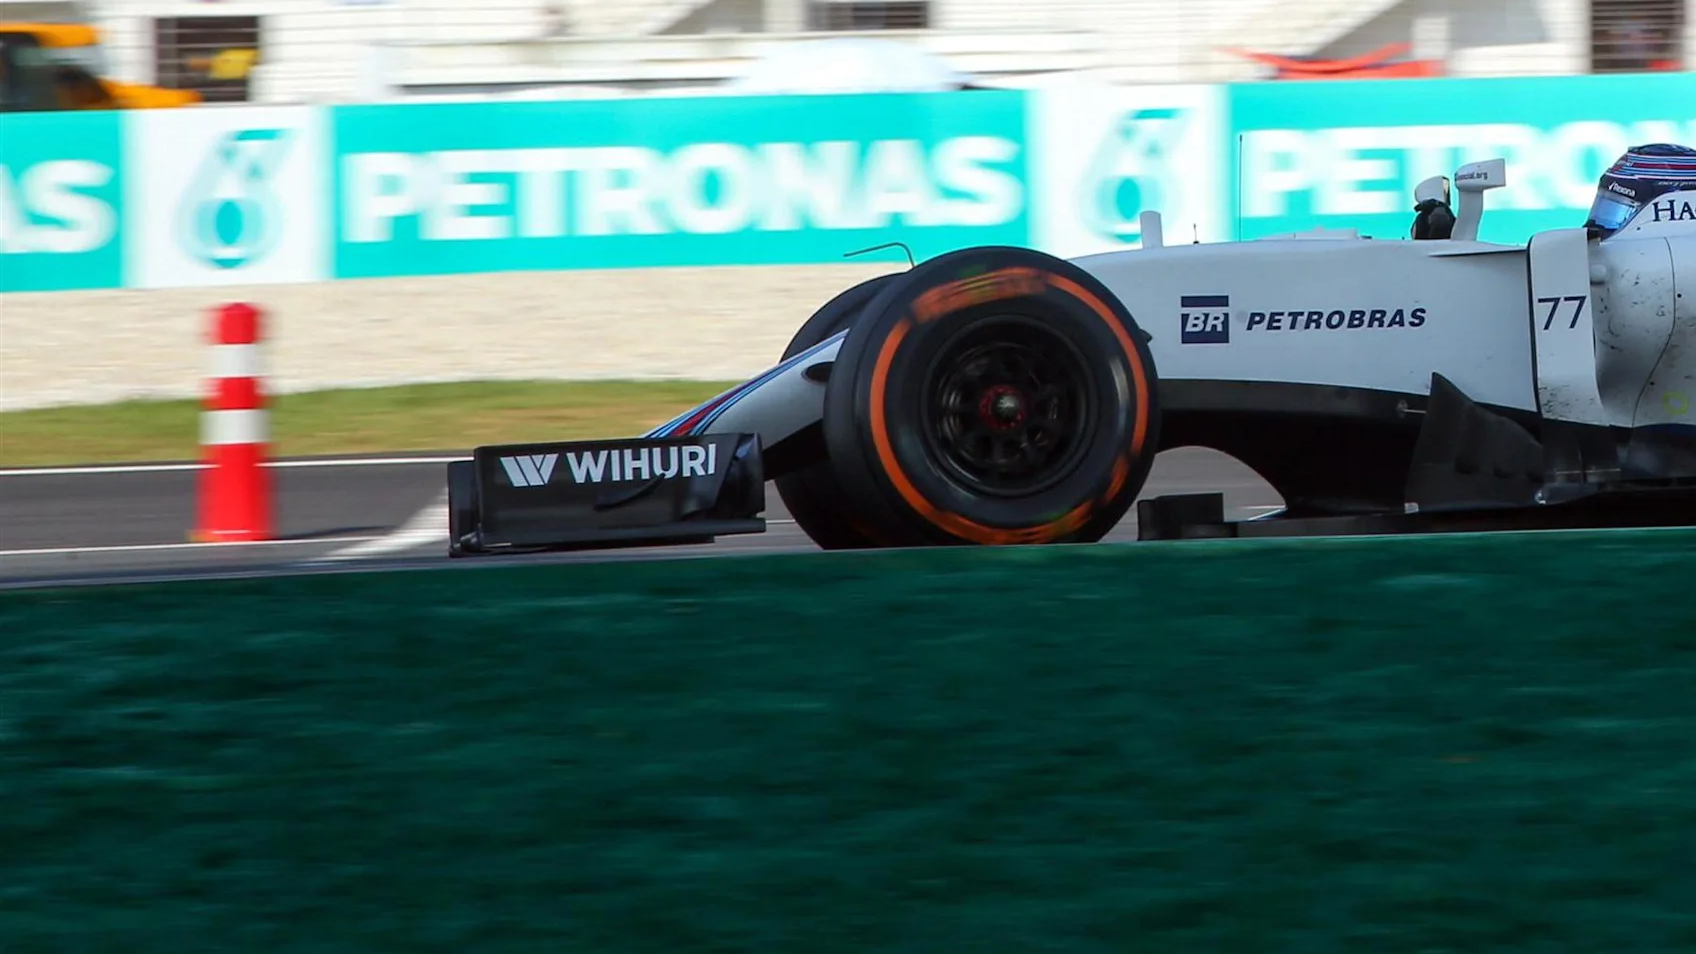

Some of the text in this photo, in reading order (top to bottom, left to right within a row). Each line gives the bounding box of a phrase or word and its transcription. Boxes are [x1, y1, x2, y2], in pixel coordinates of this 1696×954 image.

[342, 135, 1026, 242] PETRONAS
[1246, 308, 1427, 331] PETROBRAS
[1537, 296, 1587, 330] 77
[566, 444, 716, 483] WIHURI
